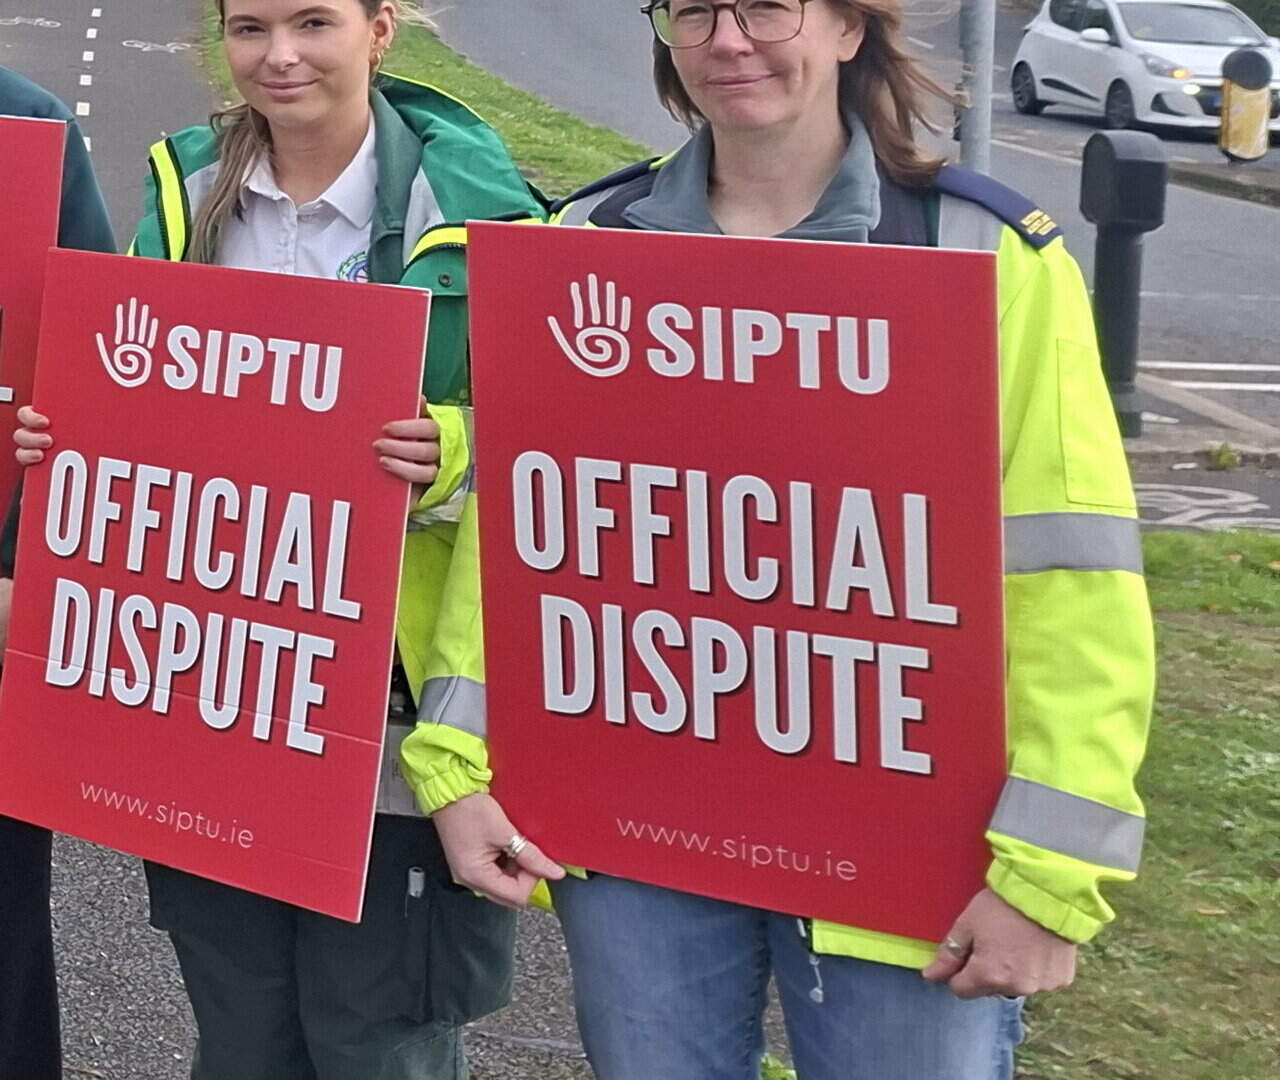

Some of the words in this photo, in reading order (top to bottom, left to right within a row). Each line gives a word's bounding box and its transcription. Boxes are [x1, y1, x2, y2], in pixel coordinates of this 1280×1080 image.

[164, 325, 342, 412] SIPTU
[646, 303, 890, 394] SIPTU
[45, 450, 361, 620] OFFICIAL
[512, 450, 957, 625] OFFICIAL
[45, 578, 335, 754] DISPUTE
[541, 595, 931, 774] DISPUTE
[80, 781, 254, 849] www.siptu.ie
[616, 817, 858, 881] www.siptu.ie
